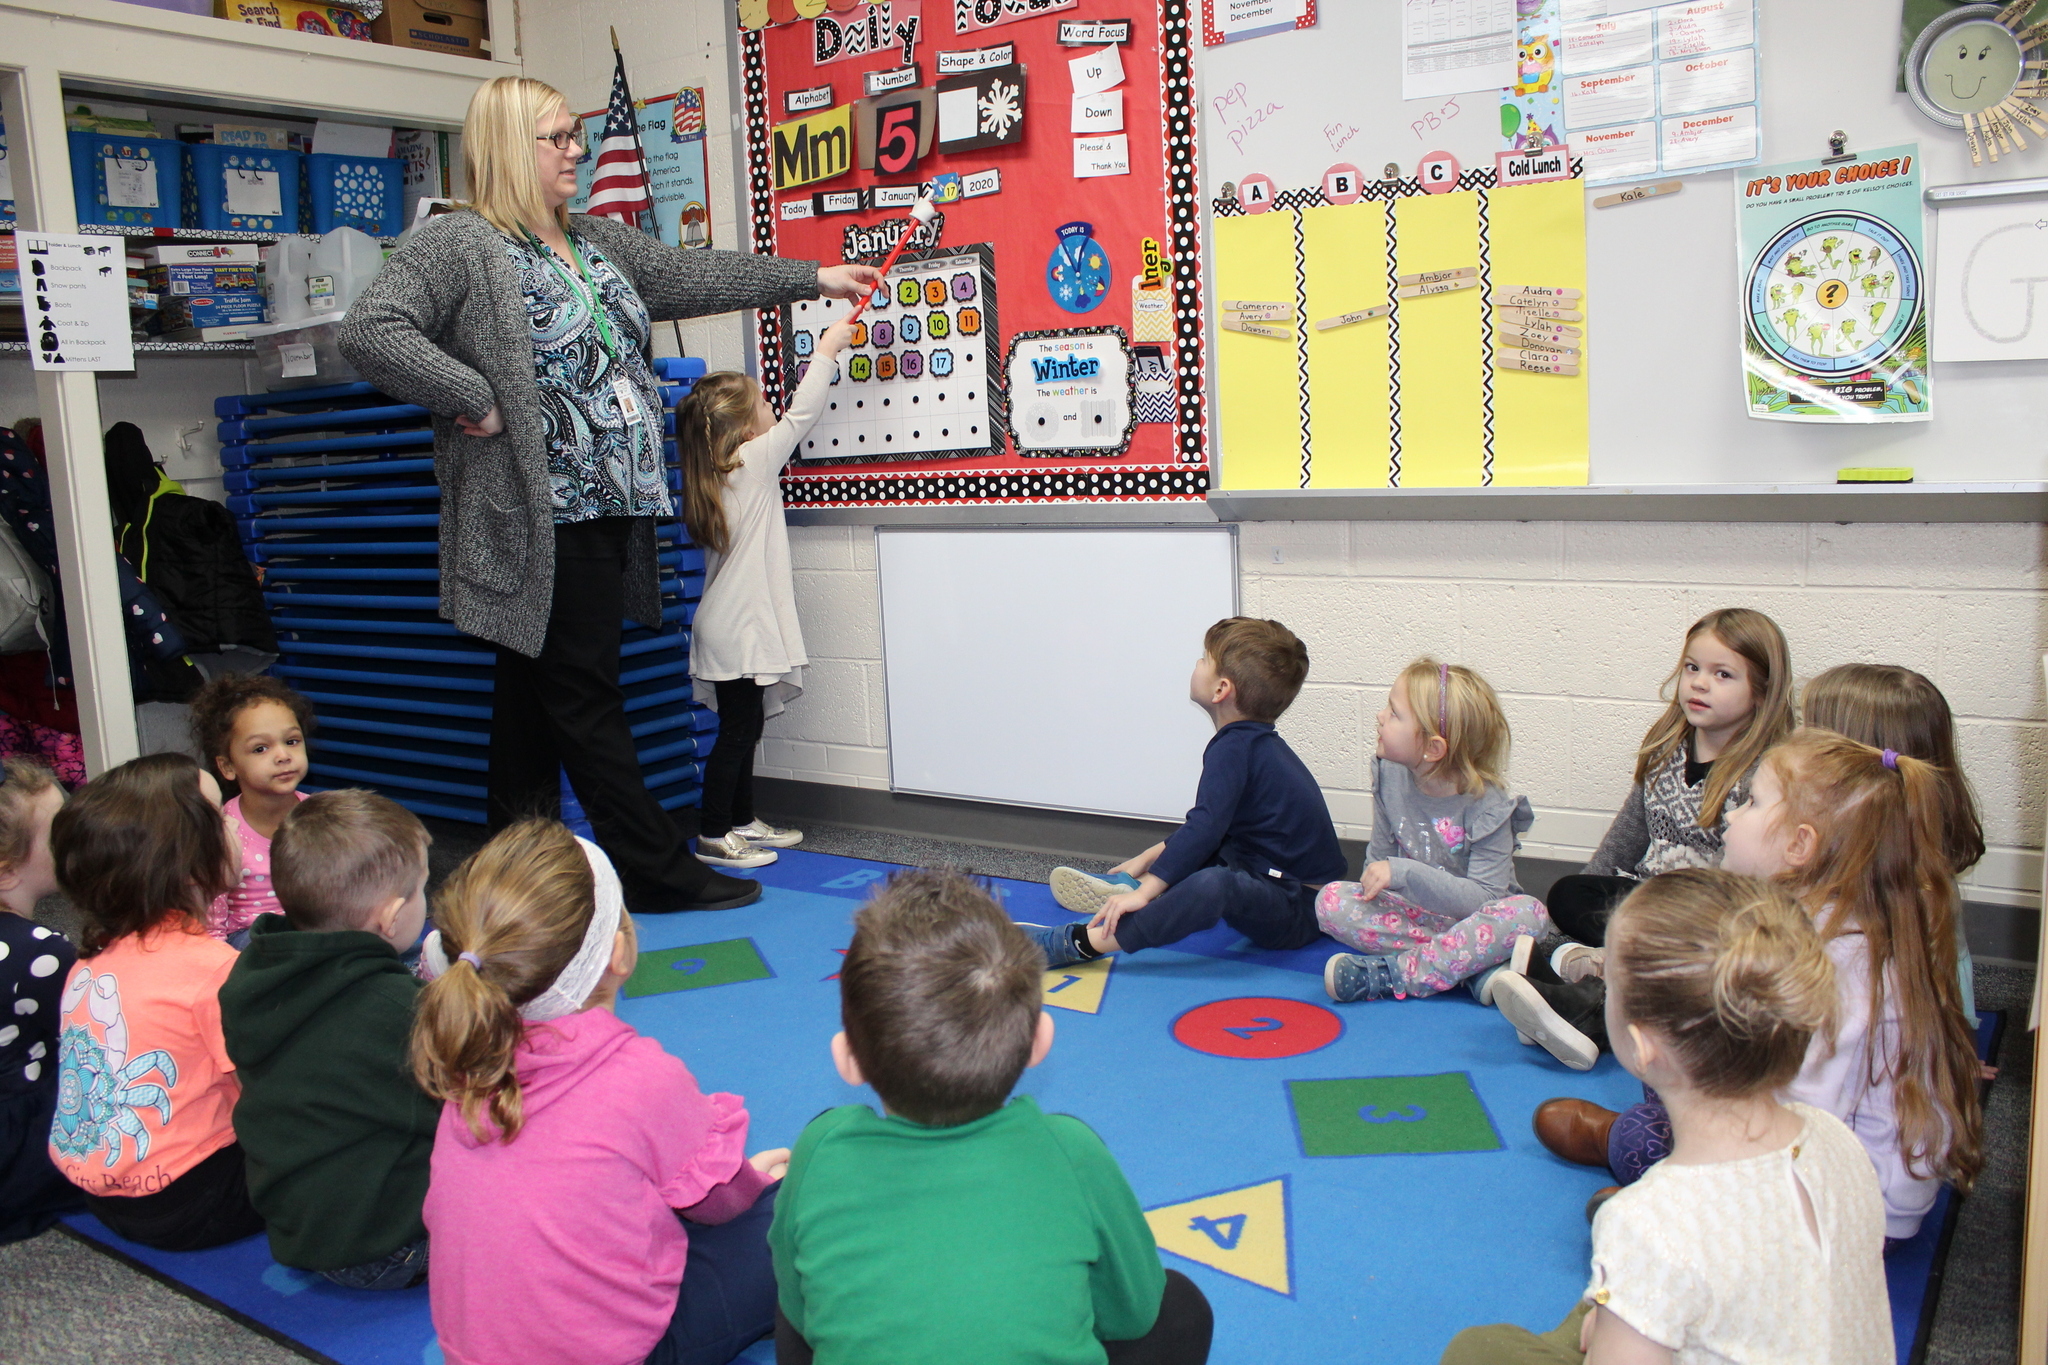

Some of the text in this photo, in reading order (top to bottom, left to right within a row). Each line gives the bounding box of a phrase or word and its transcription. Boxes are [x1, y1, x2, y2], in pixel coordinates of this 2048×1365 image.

[237, 1, 279, 16] Search
[1230, 7, 1274, 22] December
[1687, 1, 1725, 15] August
[256, 15, 281, 29] Find
[1595, 21, 1617, 32] July
[418, 31, 468, 45] SCHOLASTIC
[813, 2, 919, 64] Daily
[1063, 26, 1125, 38] Word Focus
[941, 50, 1012, 68] Shape & Color
[1685, 58, 1729, 72] October
[876, 73, 913, 88] Number
[1086, 68, 1103, 79] Up
[1580, 73, 1636, 89] September
[795, 90, 829, 107] Alphabet
[1212, 82, 1247, 125] pep
[1085, 106, 1113, 119] Down
[648, 119, 666, 131] Flag
[1227, 102, 1284, 156] pizza
[1683, 114, 1734, 130] December
[220, 130, 267, 142] READ TO
[1323, 123, 1343, 142] Fun
[1330, 124, 1360, 154] Lunch
[1586, 130, 1636, 144] November
[880, 107, 916, 173] 5
[396, 143, 424, 155] AMAZING
[1080, 143, 1104, 152] Please
[645, 151, 679, 164] to the flag
[773, 123, 847, 188] Mm
[652, 165, 680, 177] America
[1091, 161, 1126, 171] Thank You
[1430, 164, 1443, 182] C
[1509, 155, 1561, 177] Cold Lunch
[665, 177, 694, 188] it stands.
[970, 180, 994, 193] 2020
[1336, 177, 1349, 193] B
[1745, 175, 1782, 197] IT'S
[1785, 168, 1831, 192] YOUR
[653, 193, 686, 204] indivisible.
[881, 191, 917, 204] January
[946, 187, 957, 197] 17
[1251, 185, 1263, 202] A
[1620, 190, 1645, 202] Kale
[1768, 199, 1782, 207] HAVE
[1862, 185, 1885, 193] KELSO'S
[1886, 181, 1913, 189] CHOICES.
[575, 196, 587, 205] and
[829, 193, 857, 207] Friday
[782, 203, 808, 216] Today
[1061, 226, 1084, 236] TODAY IS
[213, 246, 221, 258] 4
[954, 257, 974, 265] Saturday
[1419, 272, 1452, 283] Ambjor
[906, 282, 967, 297] 2 3 4
[1420, 284, 1449, 294] Alyssa
[1522, 286, 1552, 296] Audra
[1236, 301, 1279, 311] Cameron
[1510, 295, 1549, 307] Catelyn
[1240, 312, 1263, 321] Avery
[1340, 314, 1362, 324] John
[1525, 316, 1552, 332] Lylah
[800, 316, 974, 349] 5 8 9 10 11
[1520, 327, 1549, 342] Zoey
[1039, 344, 1053, 352] The
[1054, 343, 1085, 351] season
[1521, 338, 1563, 354] Donovan
[1520, 350, 1549, 362] Clara
[855, 358, 946, 373] 14 15 16 17
[1032, 354, 1099, 381] Winter
[1520, 360, 1552, 373] Reese
[1036, 386, 1097, 397] The weather is
[1835, 386, 1852, 394] BIG
[1063, 412, 1077, 420] and
[820, 868, 883, 890] B
[1046, 974, 1083, 994] 1
[1221, 1016, 1285, 1040] 2
[1357, 1104, 1428, 1124] 3
[1187, 1212, 1248, 1250] 4
